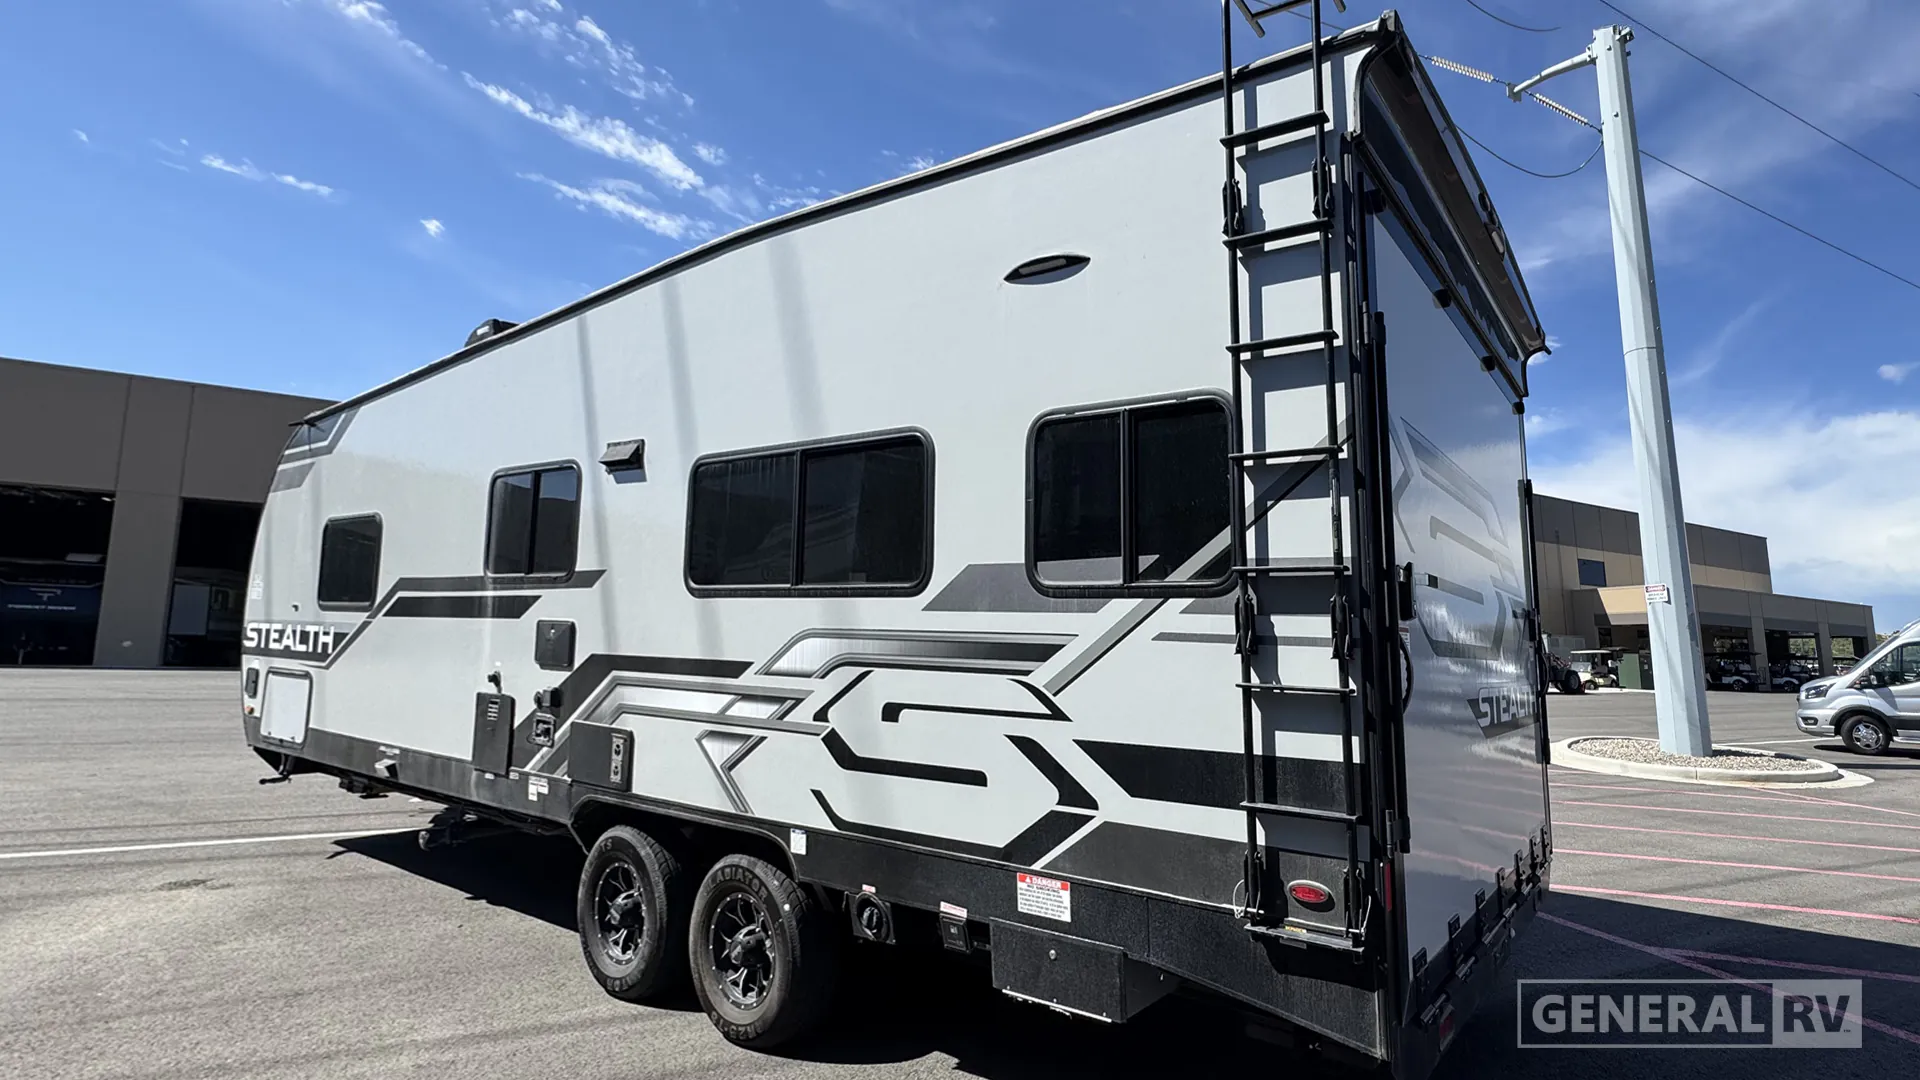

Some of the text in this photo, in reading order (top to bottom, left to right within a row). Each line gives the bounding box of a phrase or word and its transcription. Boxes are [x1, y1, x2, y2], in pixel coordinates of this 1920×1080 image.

[242, 622, 335, 655] STEALTH
[1477, 684, 1538, 728] STEALTH
[1032, 876, 1062, 890] DANGER
